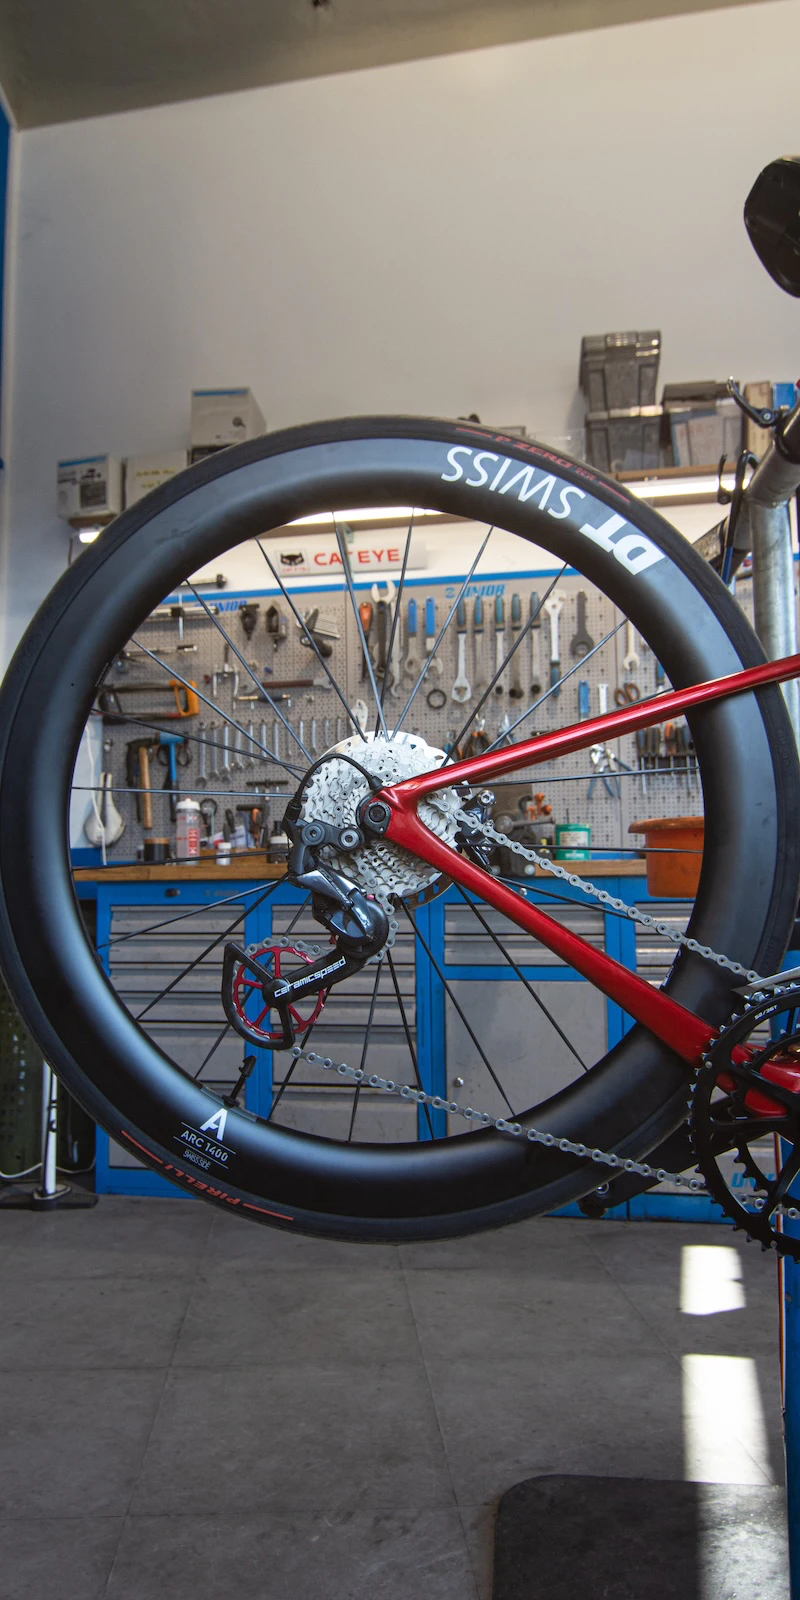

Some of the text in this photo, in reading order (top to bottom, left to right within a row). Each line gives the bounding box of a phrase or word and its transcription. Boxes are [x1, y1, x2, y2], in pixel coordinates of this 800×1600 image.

[513, 441, 573, 469] ZERO
[441, 446, 666, 576] DT SWISS
[200, 1108, 228, 1141] A
[180, 1130, 229, 1162] ARC 1400
[164, 1164, 241, 1205] PIRELLI
